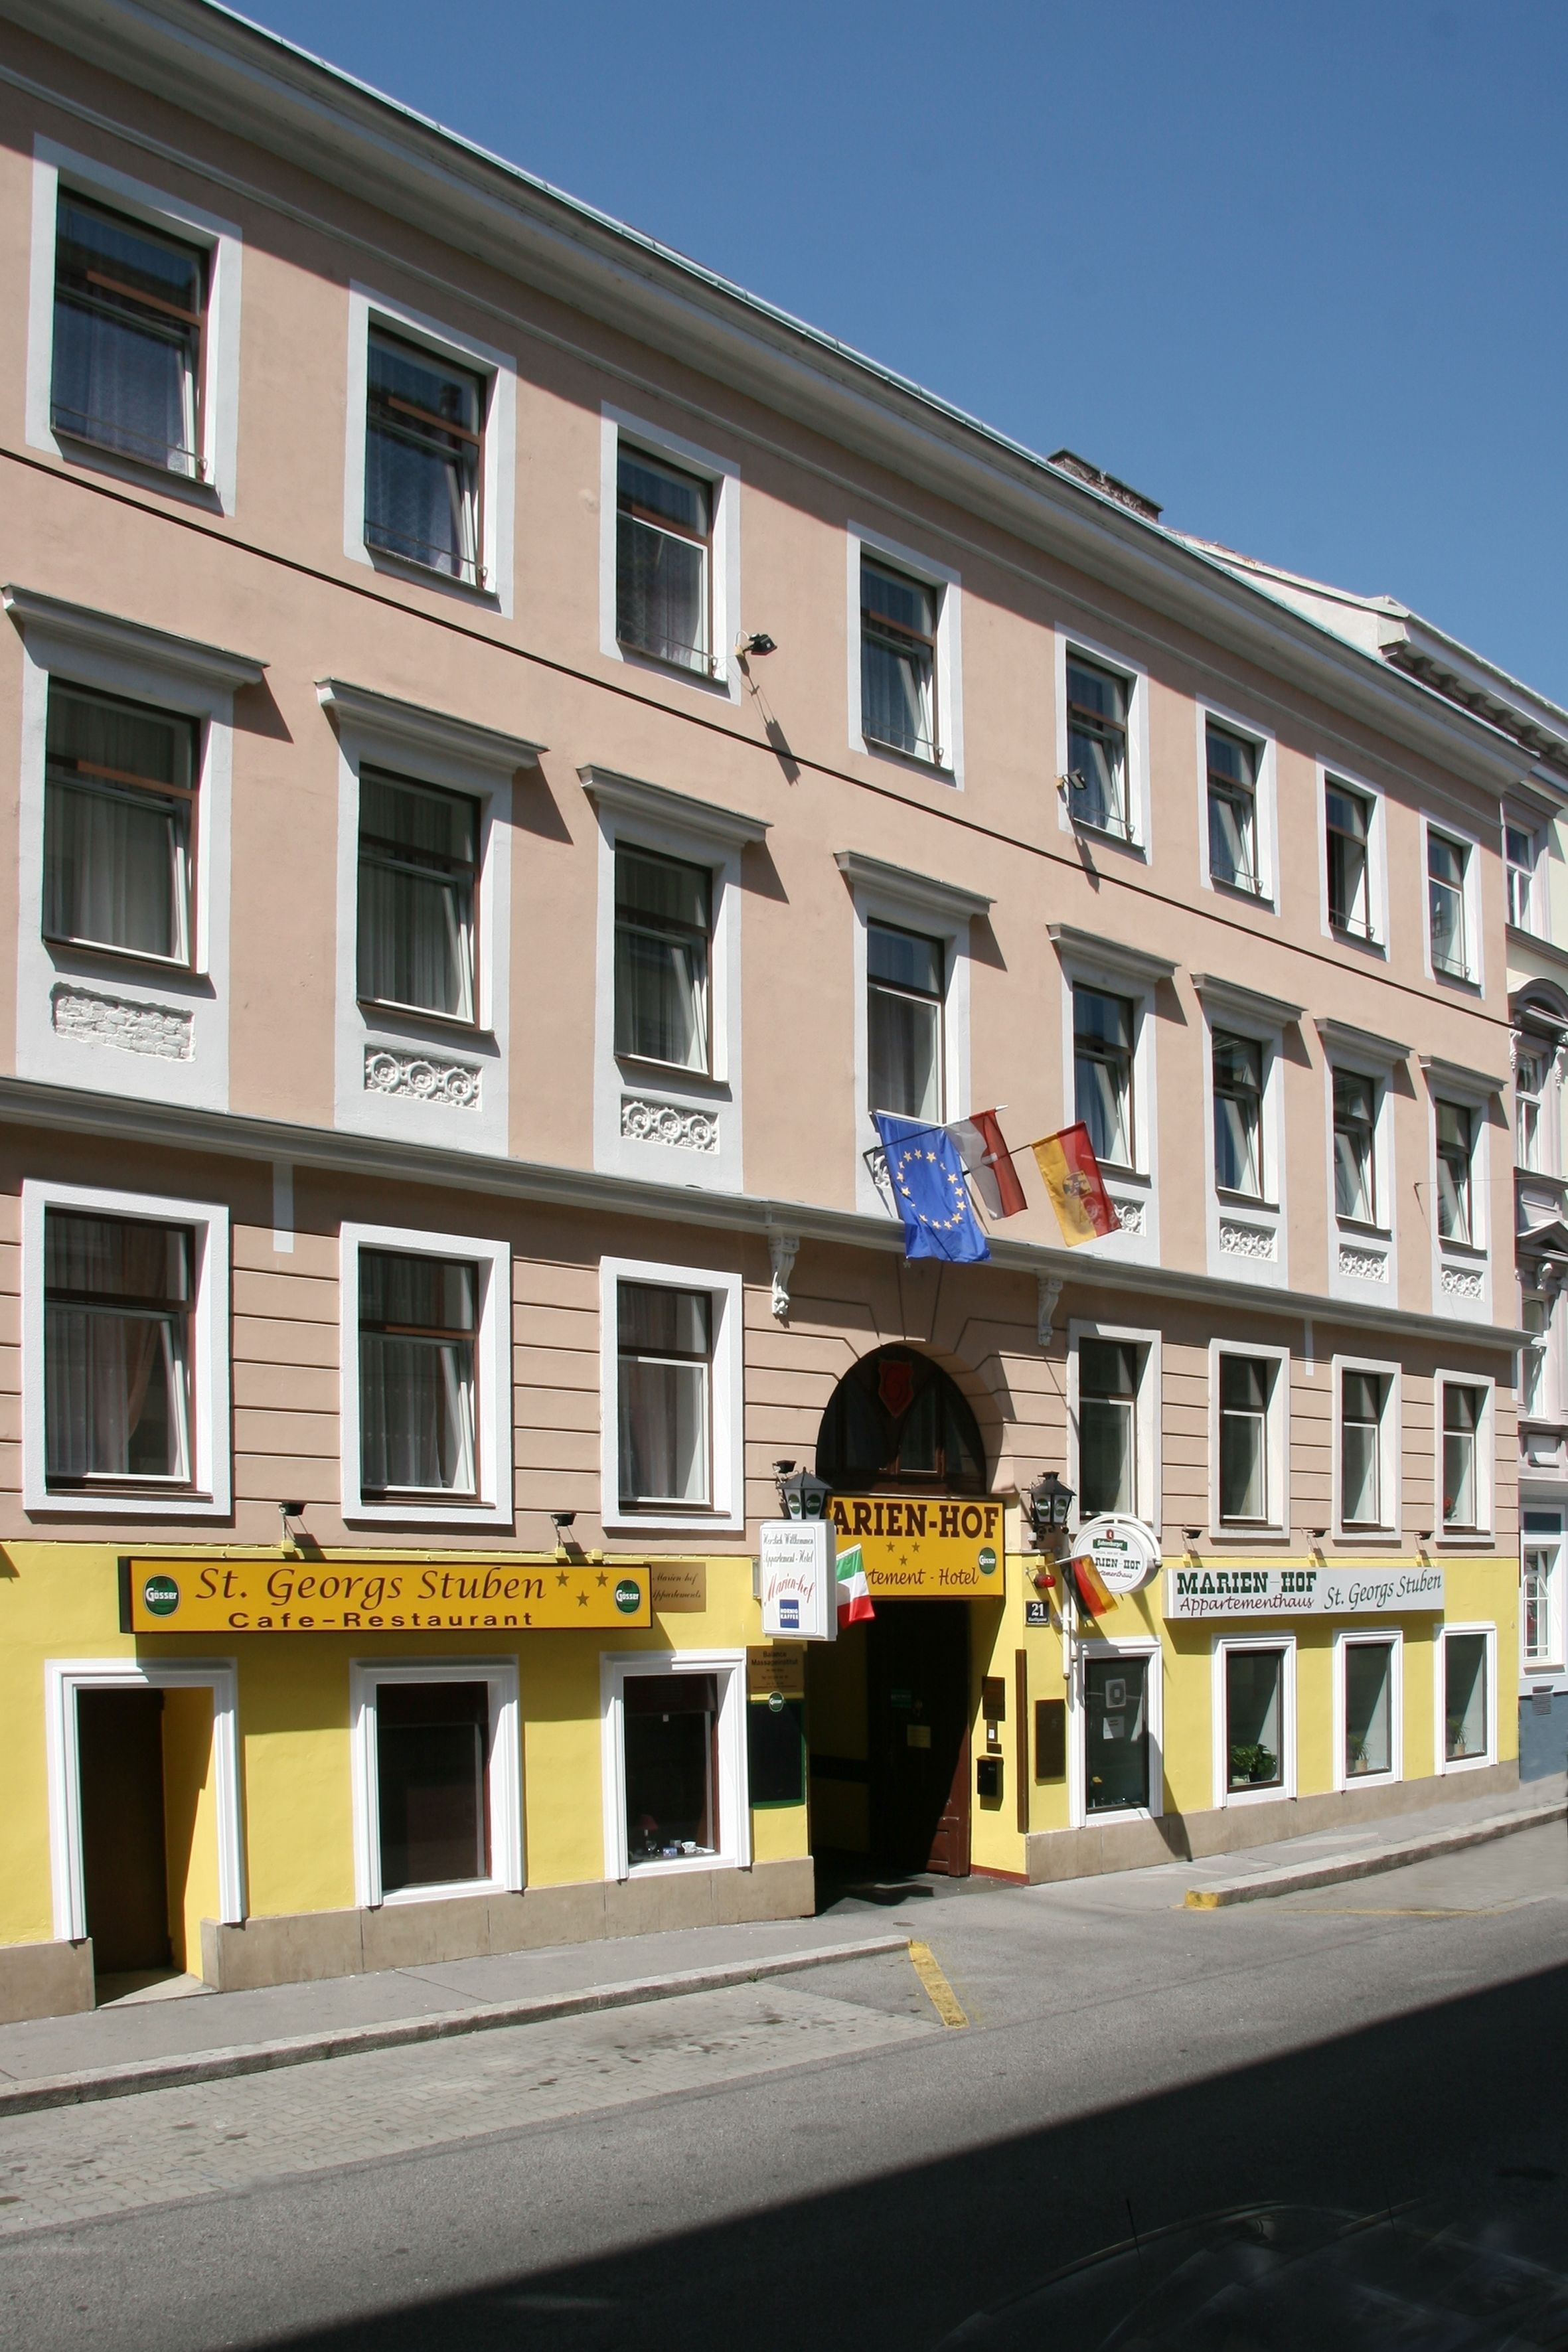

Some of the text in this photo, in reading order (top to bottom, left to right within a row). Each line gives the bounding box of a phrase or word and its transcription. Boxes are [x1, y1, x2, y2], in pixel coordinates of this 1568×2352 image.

[833, 1500, 999, 1539] ARIEN-HOF
[1095, 1557, 1141, 1570] RIEN-HOF
[865, 1569, 926, 1585] rtement
[939, 1567, 979, 1586] Hotel
[145, 1587, 177, 1603] Gösser
[195, 1566, 546, 1610] St. Georgs Stuben
[616, 1589, 639, 1601] Gösser
[1324, 1569, 1442, 1611] St. Georgs Stuben
[1032, 1603, 1044, 1616] 21
[1180, 1593, 1314, 1616] Appartementhaus
[228, 1610, 532, 1628] Cafe-Restaurant
